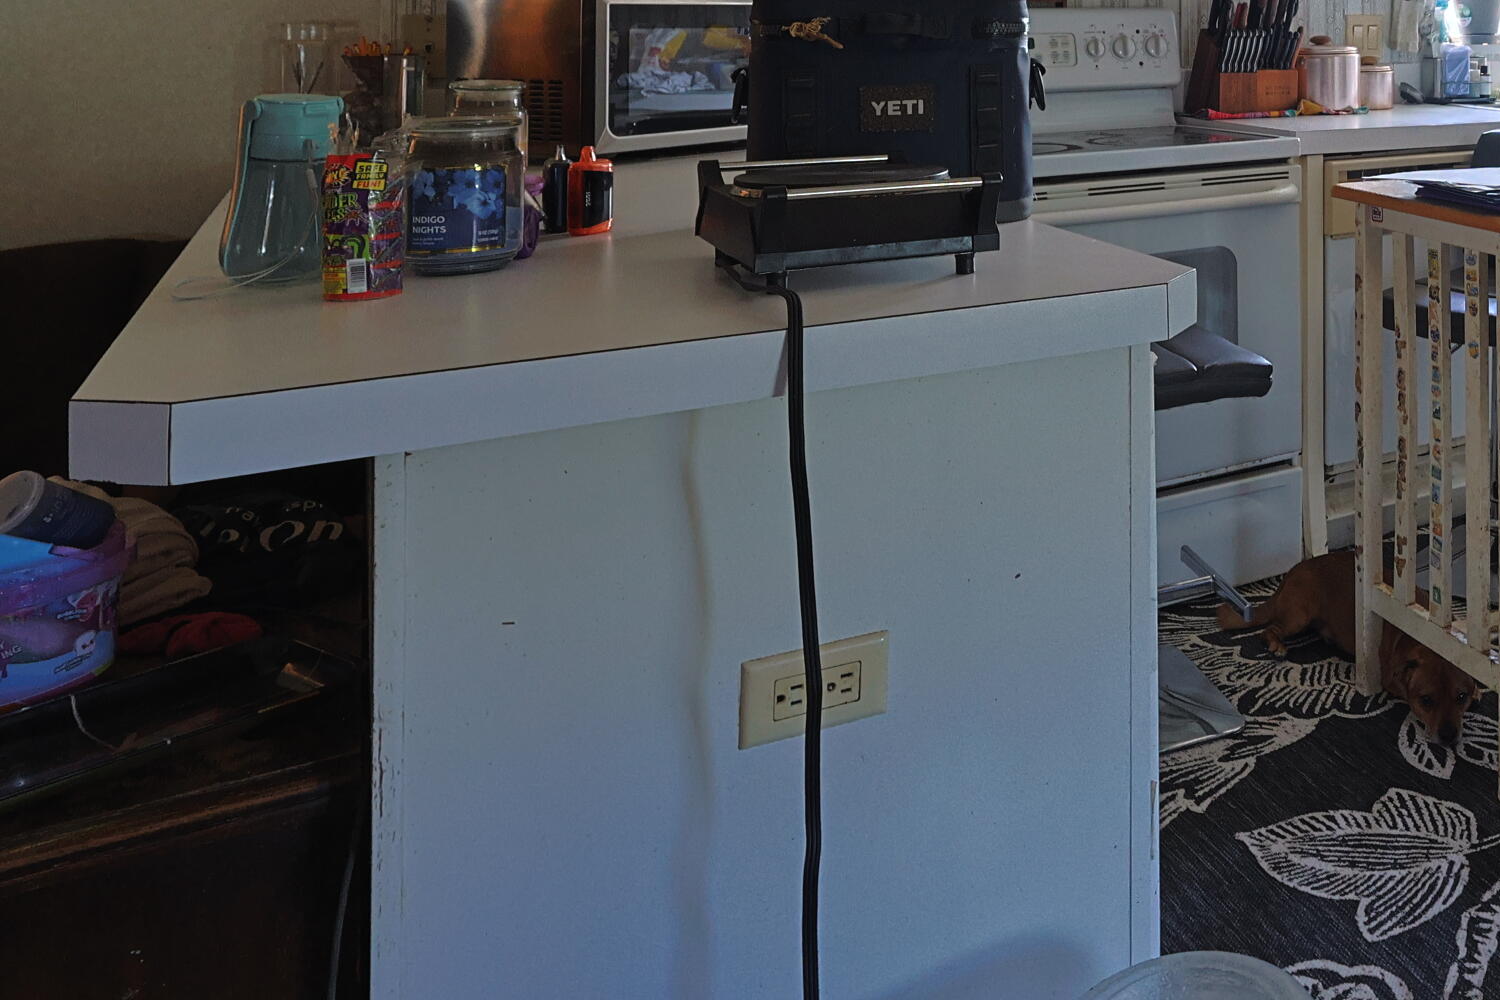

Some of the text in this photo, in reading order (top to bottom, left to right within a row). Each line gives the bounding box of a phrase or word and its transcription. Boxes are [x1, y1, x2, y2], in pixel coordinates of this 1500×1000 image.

[870, 98, 925, 117] YETI
[357, 164, 386, 173] SAFE
[355, 173, 385, 181] FAMILY
[355, 181, 383, 190] FUN!
[412, 215, 446, 224] INDIGO
[412, 225, 447, 234] NIGHTS
